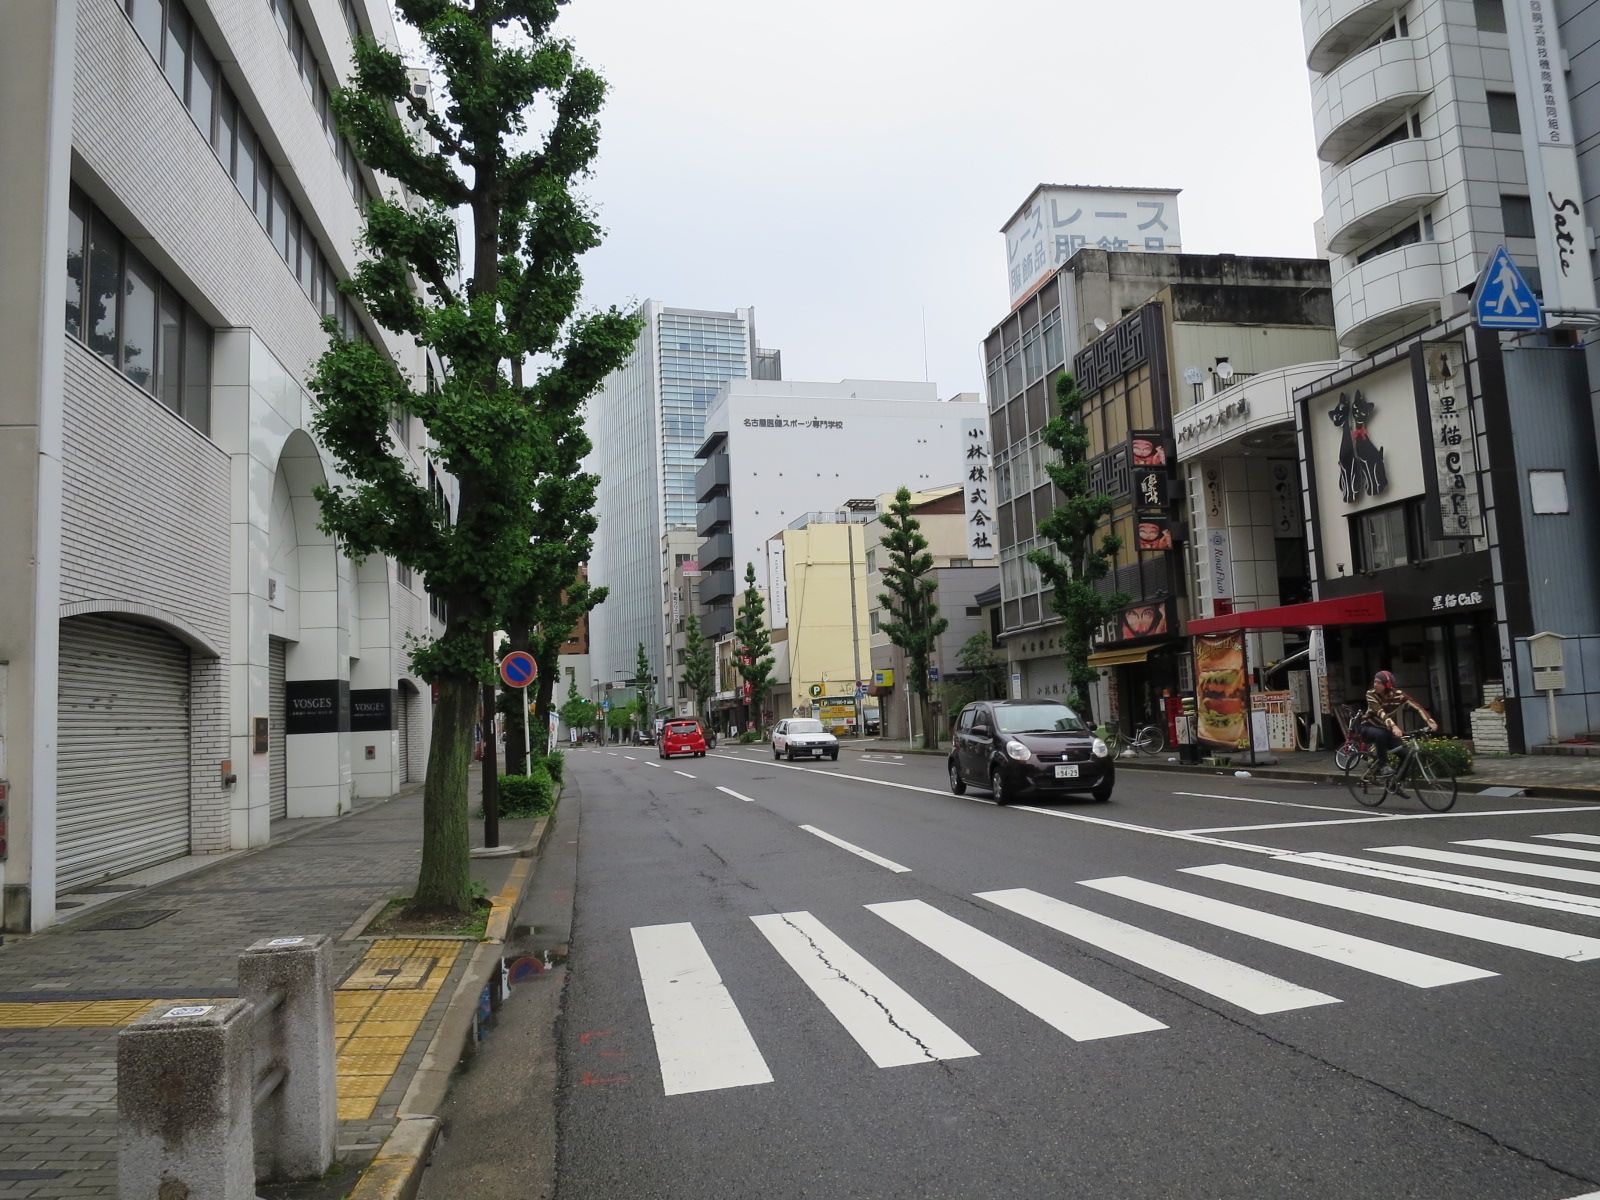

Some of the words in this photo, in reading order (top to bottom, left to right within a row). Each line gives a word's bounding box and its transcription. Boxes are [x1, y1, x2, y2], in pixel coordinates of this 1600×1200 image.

[1050, 199, 1169, 232] レース
[1548, 191, 1580, 278] Satie
[966, 427, 992, 550] 小林株式会社
[293, 698, 332, 709] VOSGES
[355, 702, 385, 711] VOSGES
